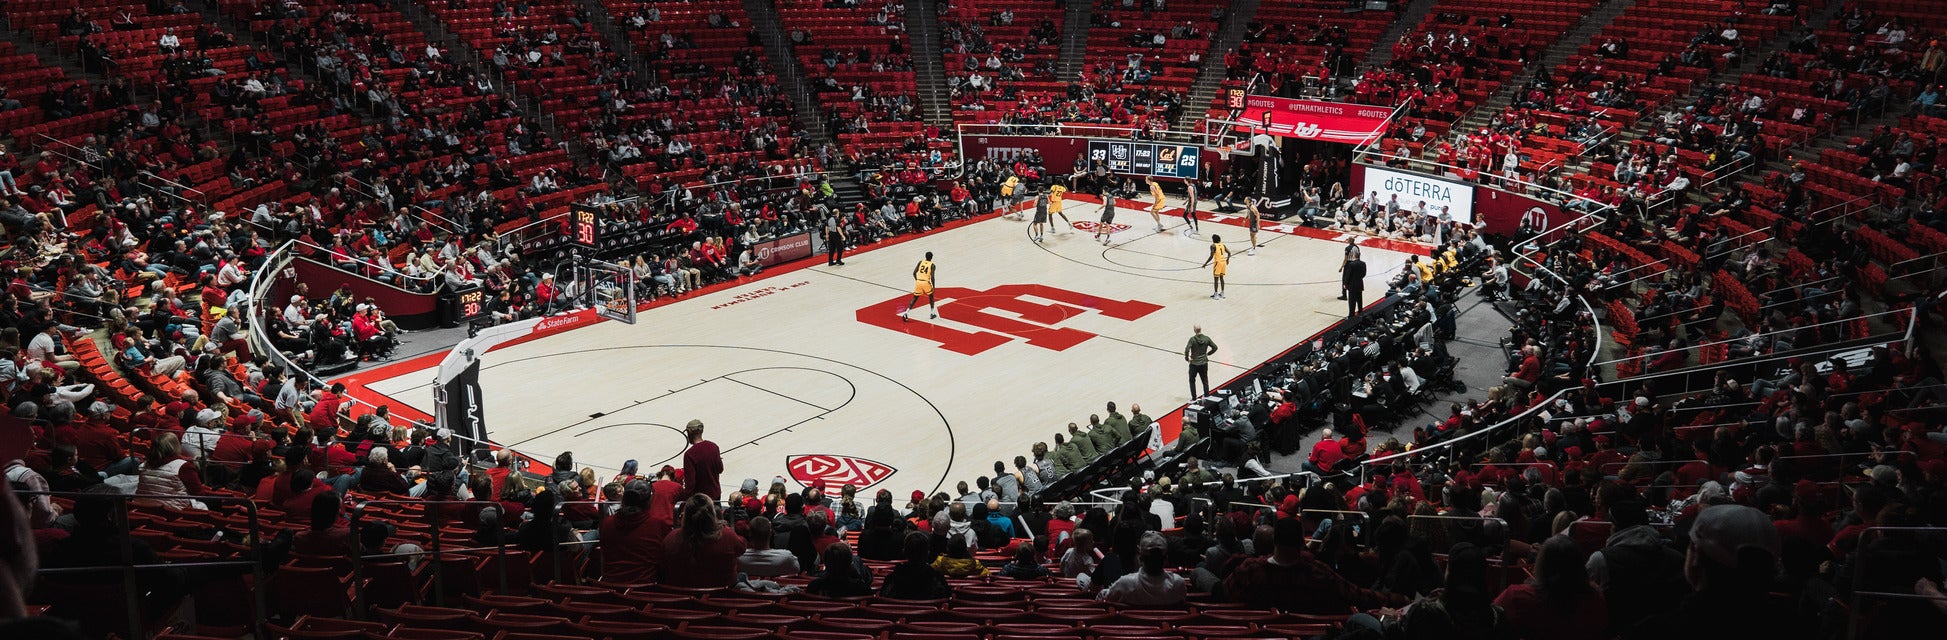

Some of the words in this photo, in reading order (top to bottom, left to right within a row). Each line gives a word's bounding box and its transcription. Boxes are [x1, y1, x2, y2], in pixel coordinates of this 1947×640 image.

[1230, 89, 1244, 97] 17:22
[1230, 96, 1243, 108] 30
[1288, 103, 1343, 115] @UTAHATHLETICS
[1357, 109, 1388, 119] #GOUTES
[1091, 149, 1106, 161] 33
[1159, 148, 1176, 162] Cal
[1180, 155, 1196, 167] 25
[1384, 176, 1452, 203] dōTERRA
[577, 210, 594, 224] 17:22
[578, 223, 593, 244] 30
[770, 243, 794, 254] CRIMSON
[794, 239, 809, 248] CLUB
[919, 265, 929, 275] 24
[461, 290, 482, 304] 17:22
[464, 302, 478, 317] 30
[1045, 465, 1054, 479] 5
